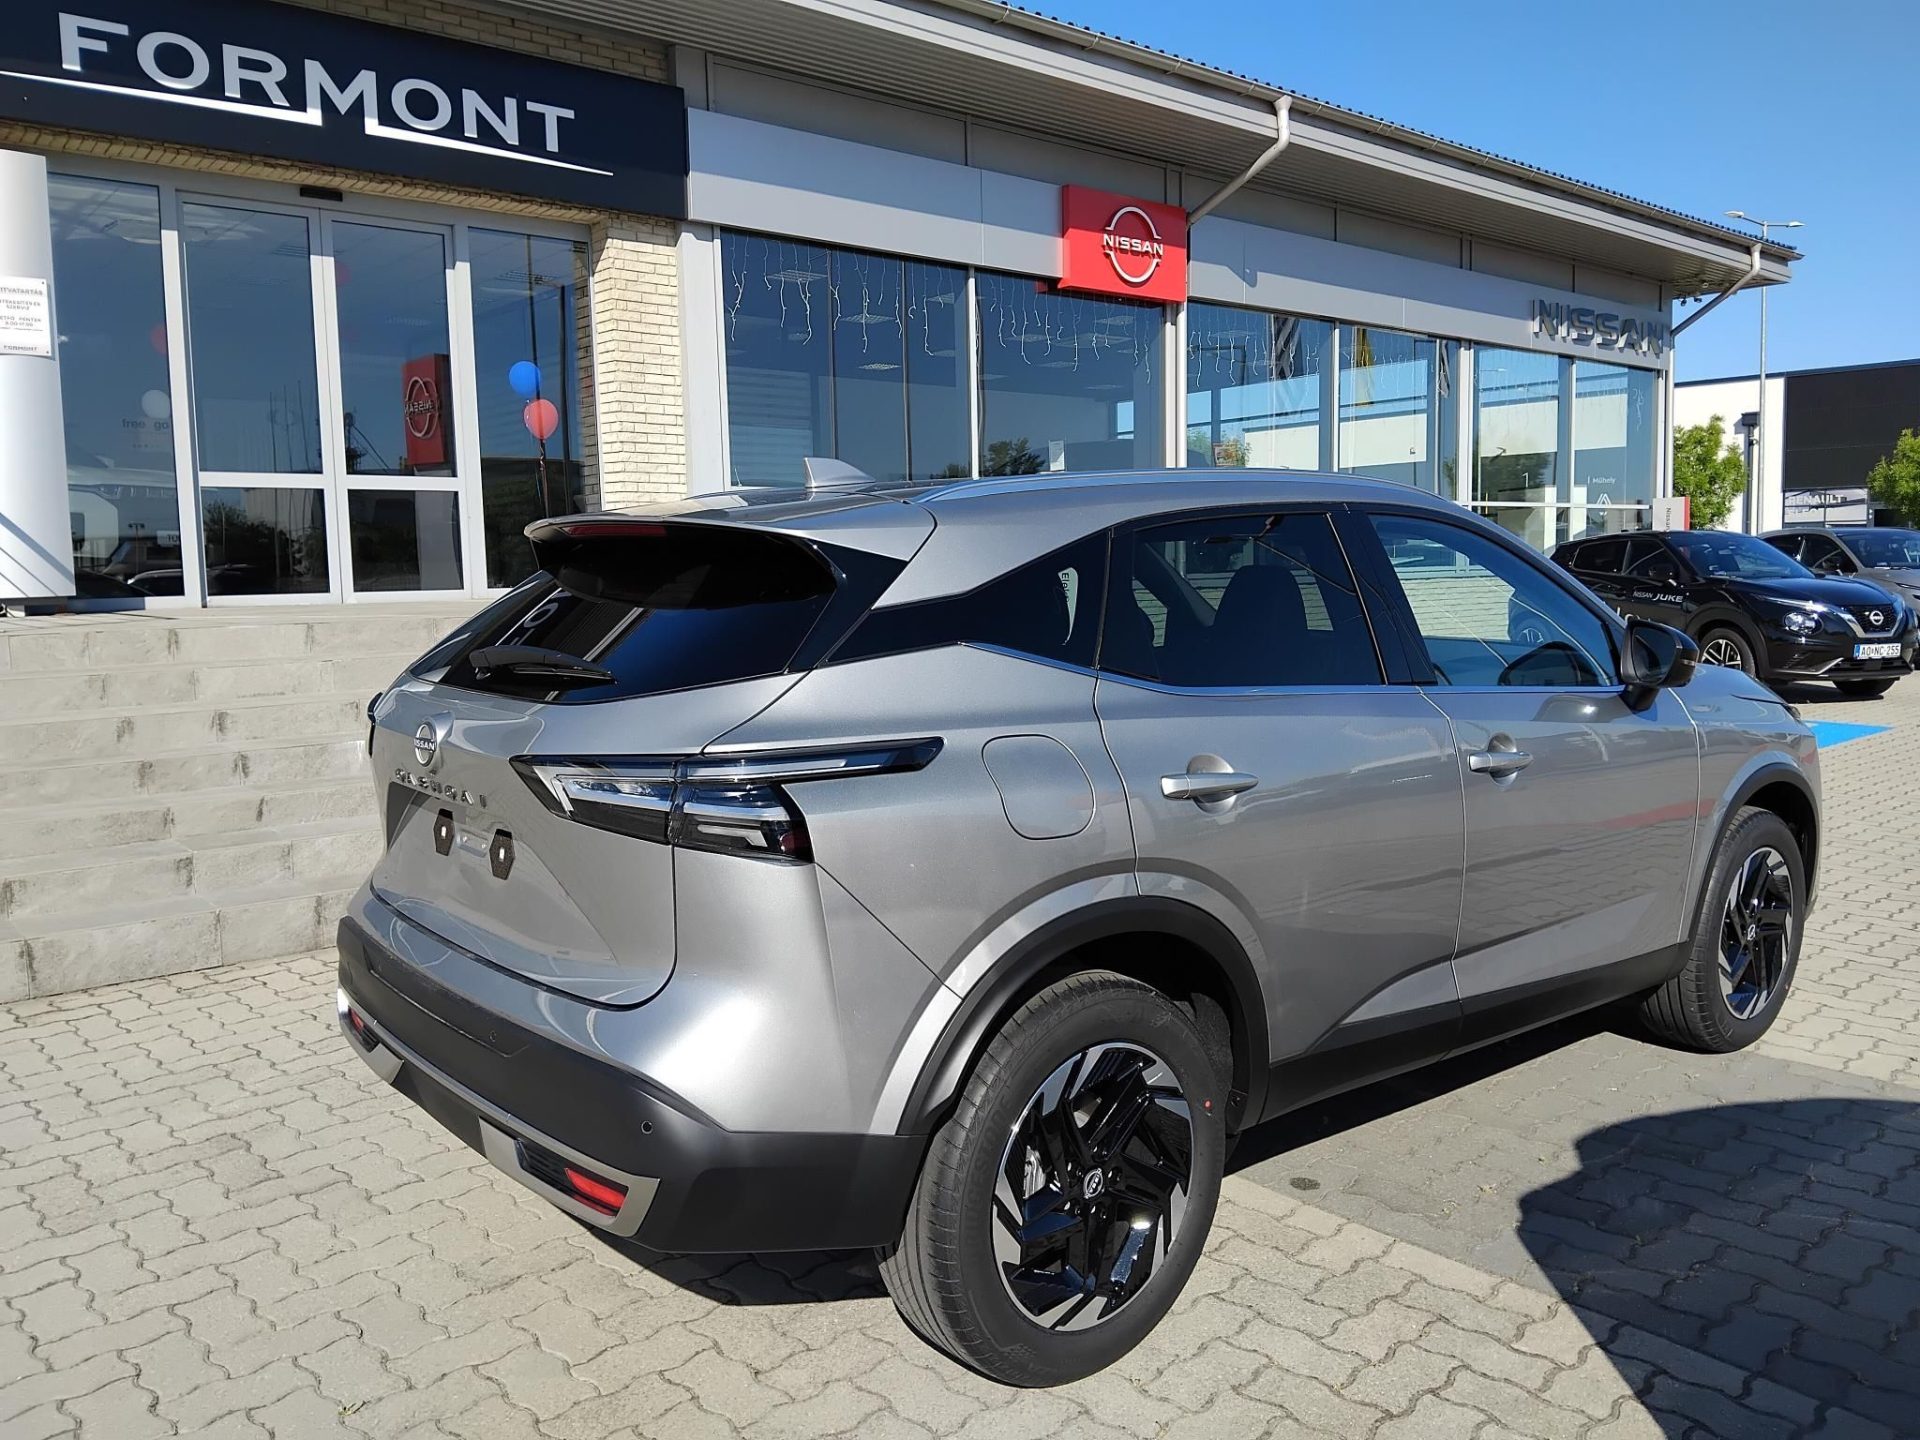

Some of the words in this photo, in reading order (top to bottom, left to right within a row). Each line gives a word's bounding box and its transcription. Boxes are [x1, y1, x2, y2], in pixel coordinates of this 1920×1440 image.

[58, 12, 576, 153] FORMONT
[1103, 233, 1164, 256] NISSAN
[1532, 299, 1664, 356] NISSAN
[1785, 494, 1844, 506] RENAULT
[1652, 593, 1684, 603] JUKE
